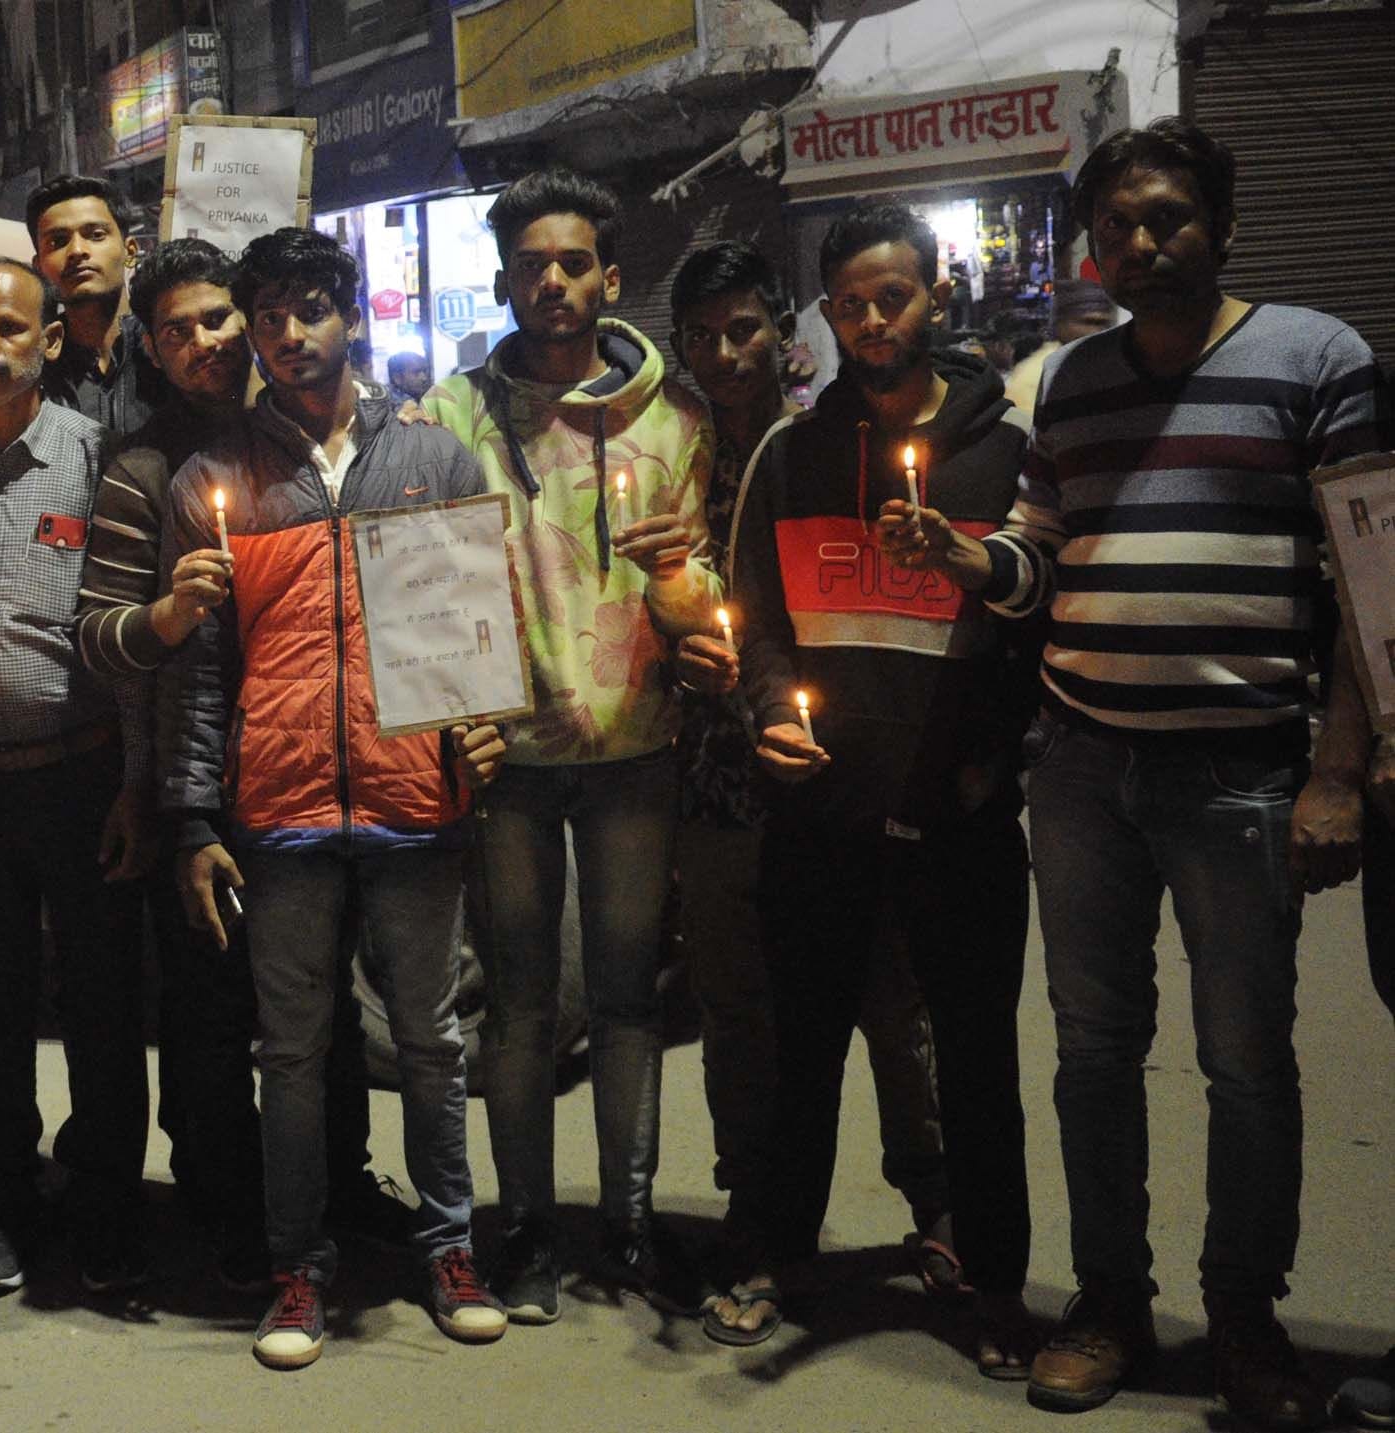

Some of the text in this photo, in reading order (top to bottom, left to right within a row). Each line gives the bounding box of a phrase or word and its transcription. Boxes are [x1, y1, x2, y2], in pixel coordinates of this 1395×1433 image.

[383, 85, 443, 128] Galaxy
[883, 102, 944, 152] पान
[212, 162, 261, 175] JUSTICE
[216, 186, 241, 198] FOR
[208, 210, 269, 225] PRIYANKA
